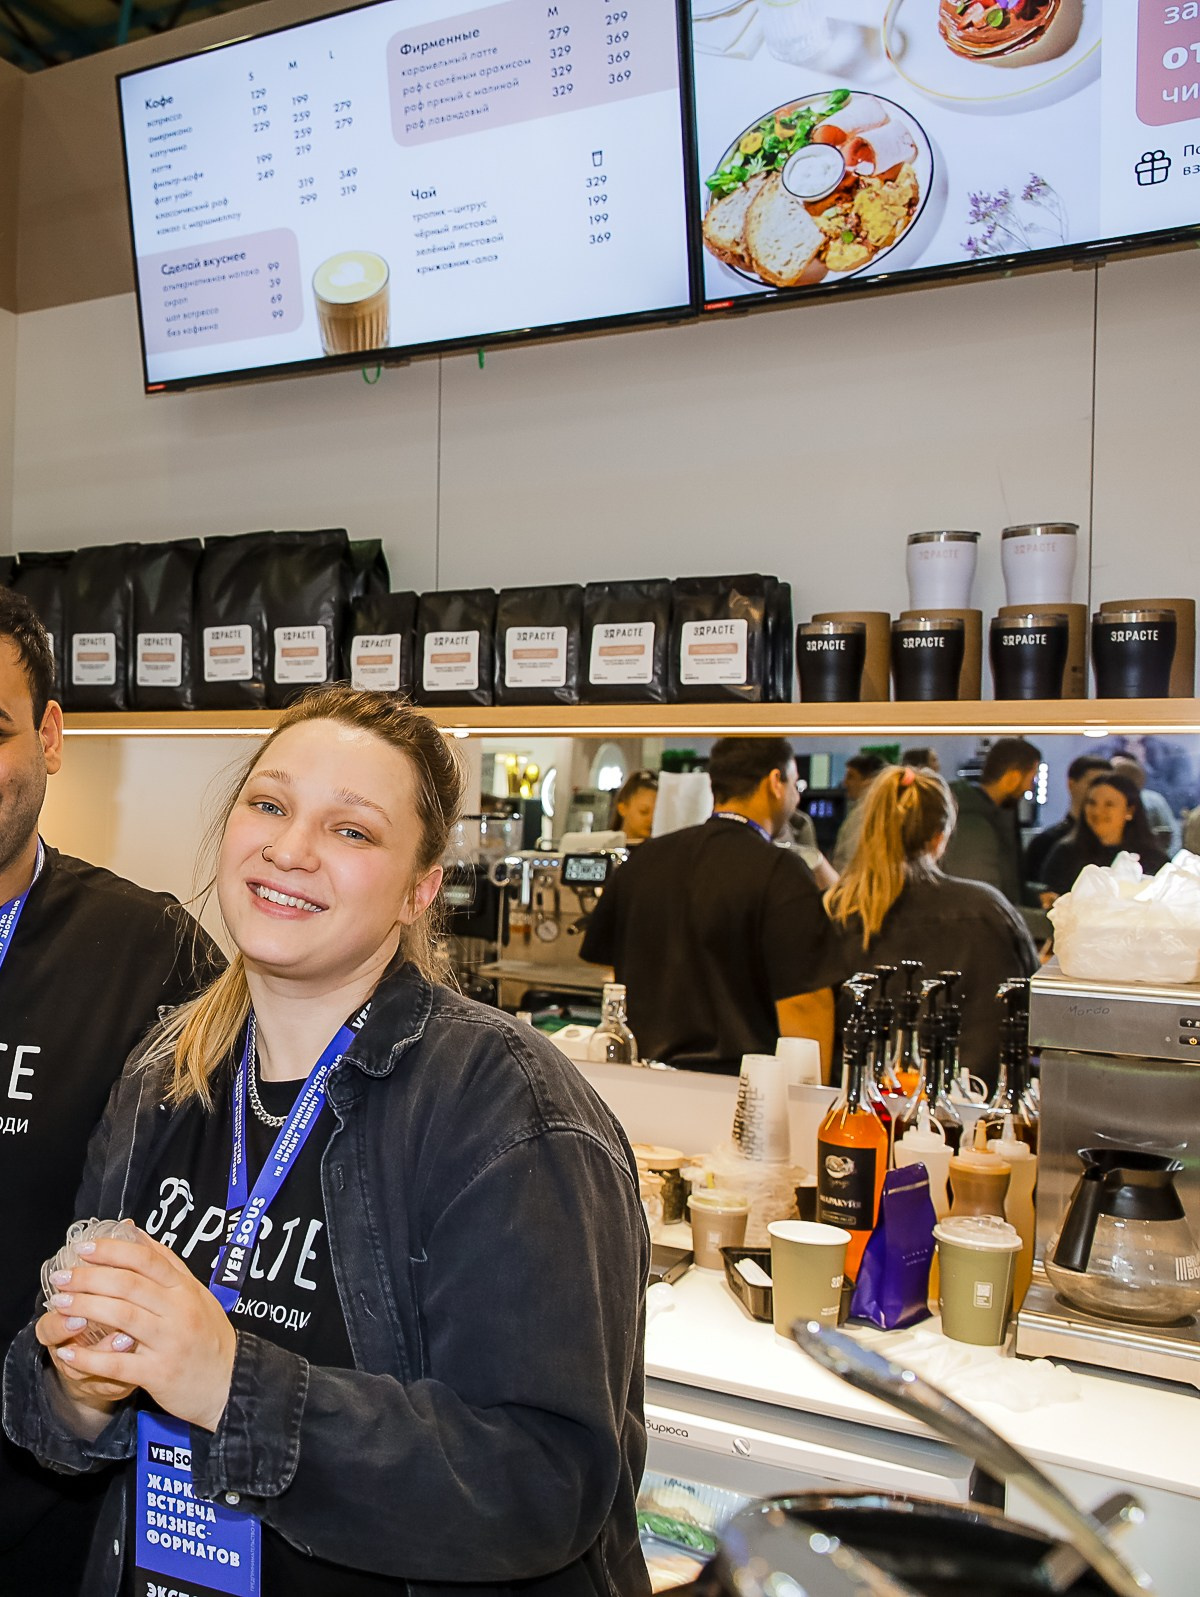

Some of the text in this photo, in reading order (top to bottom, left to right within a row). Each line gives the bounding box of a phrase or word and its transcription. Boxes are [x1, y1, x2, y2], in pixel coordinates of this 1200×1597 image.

[547, 6, 558, 17] M
[400, 29, 480, 55] Фирменные
[402, 10, 628, 76] карамельный латте 279 299
[249, 50, 333, 81] S M L
[403, 82, 423, 98] раф
[479, 58, 531, 77] арахисом
[550, 44, 571, 59] 329
[606, 30, 629, 45] 369
[251, 88, 267, 99] 129
[404, 100, 424, 116] раф
[427, 91, 463, 109] пряный
[474, 77, 519, 96] малиной
[551, 64, 572, 78] 329
[607, 50, 631, 65] 369
[145, 96, 174, 110] Кофе
[252, 104, 268, 116] 179
[292, 94, 309, 105] 199
[406, 69, 632, 133] раф лавандовый 329 369
[253, 120, 271, 132] 229
[293, 110, 311, 123] 259
[333, 100, 352, 112] 279
[294, 127, 312, 139] 259
[335, 117, 353, 129] 279
[256, 153, 273, 164] 199
[295, 144, 312, 156] 219
[257, 169, 275, 181] 249
[298, 177, 314, 188] 319
[339, 167, 358, 179] 349
[586, 175, 607, 188] 329
[300, 193, 318, 205] 299
[341, 184, 357, 196] 319
[411, 186, 437, 200] Чай
[452, 215, 497, 232] листовой
[588, 194, 608, 206] 199
[458, 233, 504, 248] листовой
[589, 213, 609, 225] 199
[589, 232, 611, 244] 369
[161, 252, 246, 275] Сделай вкуснее
[267, 261, 280, 271] 99
[269, 278, 281, 288] 39
[271, 294, 283, 304] 69
[272, 309, 284, 319] 99
[3, 900, 21, 939] ЗДОРОВЬЮ
[274, 1065, 328, 1161] ПРЕДПРИНИМАТЕЛЬСТВО
[273, 1165, 284, 1177] НЕ
[281, 1132, 301, 1163] ВРЕДИТ
[299, 1095, 320, 1130] ВАШЕМУ
[151, 1446, 192, 1466] VERSO
[147, 1492, 216, 1523] ВСТРЕЧА
[146, 1510, 211, 1539] БИЗНЕС-
[146, 1529, 240, 1567] ФОРМАТОВ
